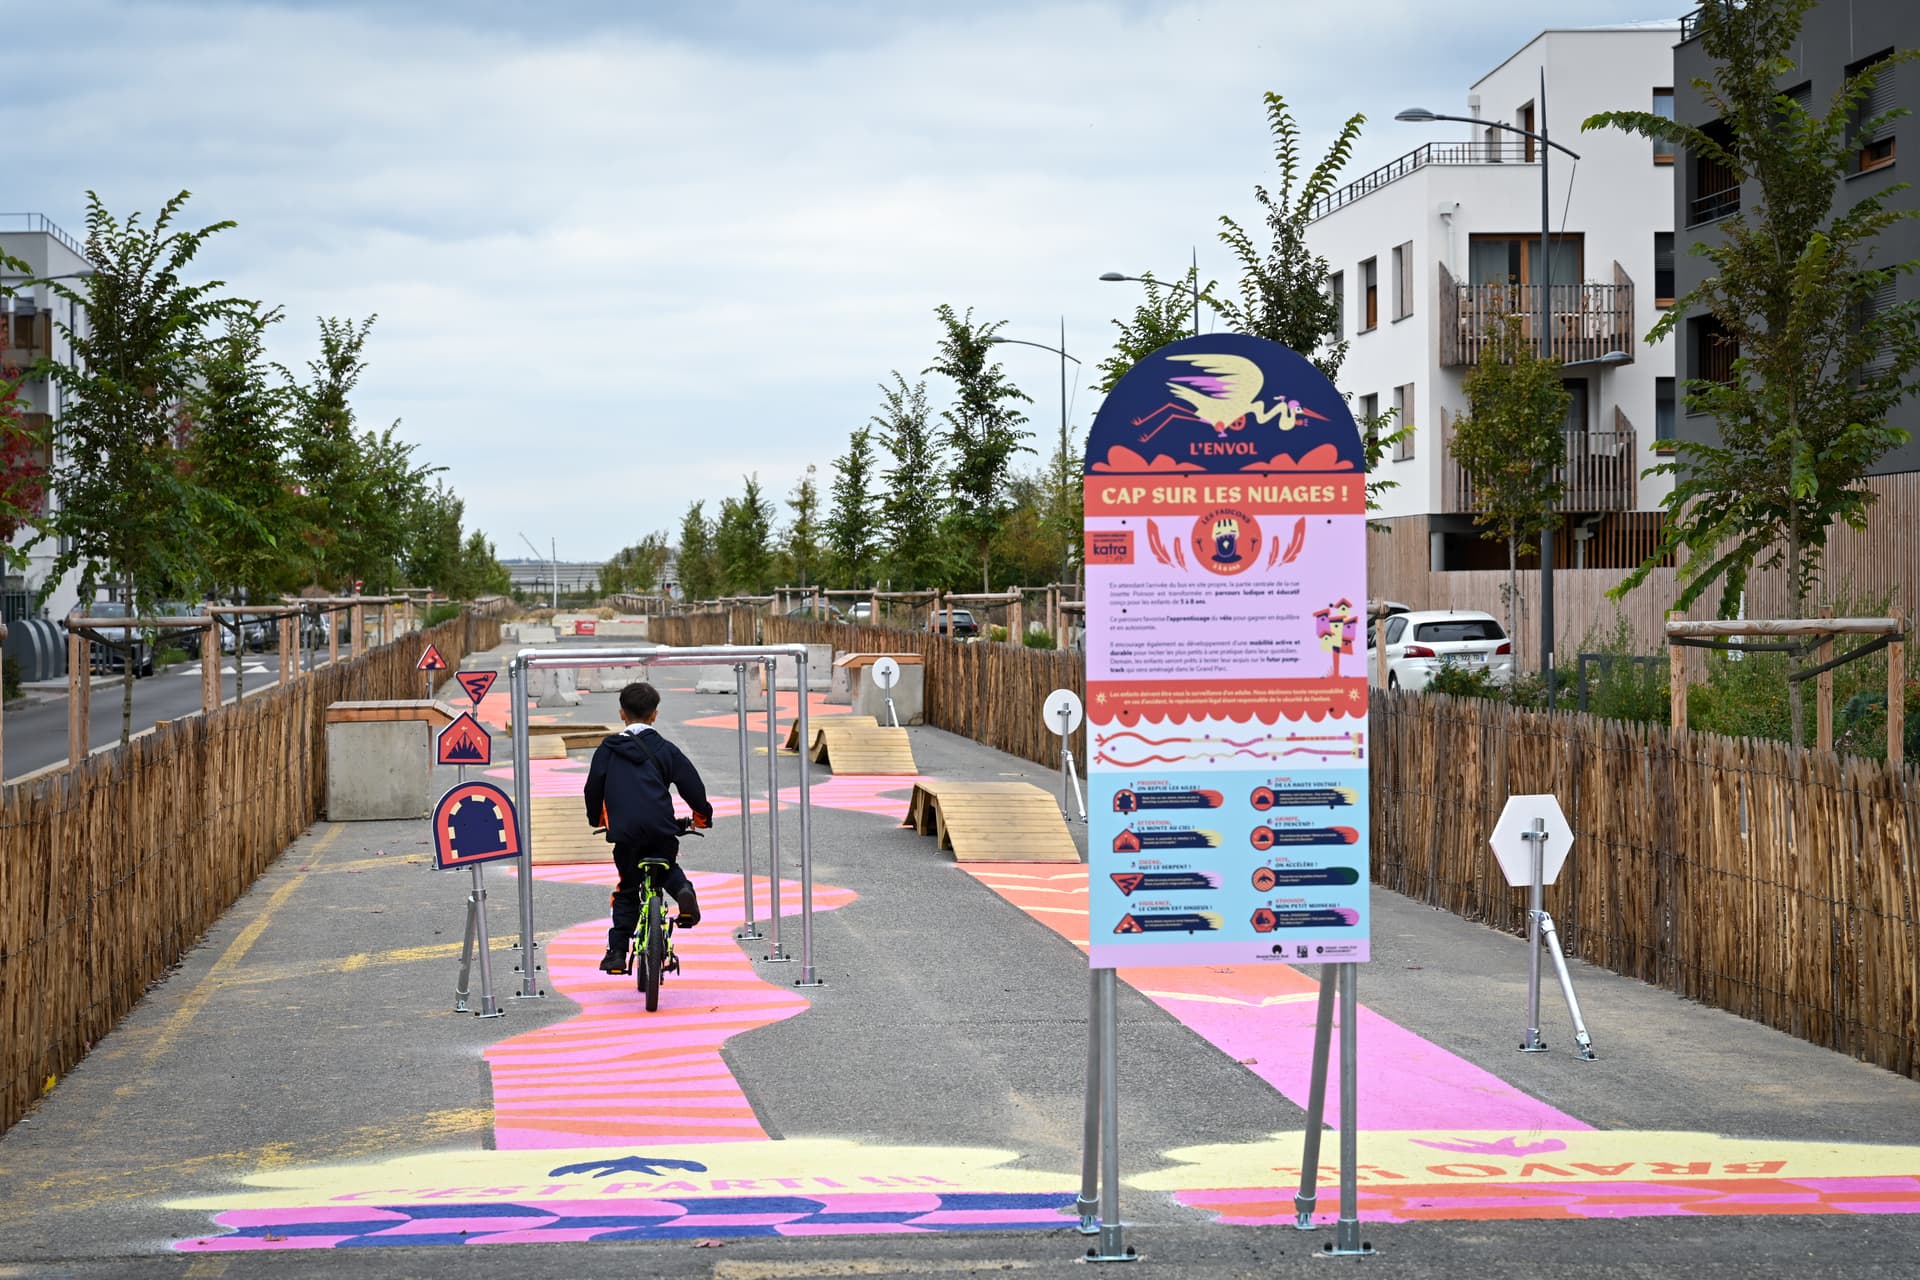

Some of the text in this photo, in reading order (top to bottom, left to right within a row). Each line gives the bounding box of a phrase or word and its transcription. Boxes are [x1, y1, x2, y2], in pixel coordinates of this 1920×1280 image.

[1190, 442, 1258, 456] L'ENVOL
[1102, 486, 1348, 506] CAP SUR LES NUAGES !
[1216, 508, 1251, 524] FAUCONS
[1093, 544, 1127, 556] katra
[1424, 1160, 1788, 1178] BRAVO
[329, 1183, 583, 1202] C'EST
[599, 1176, 849, 1194] PARTI
